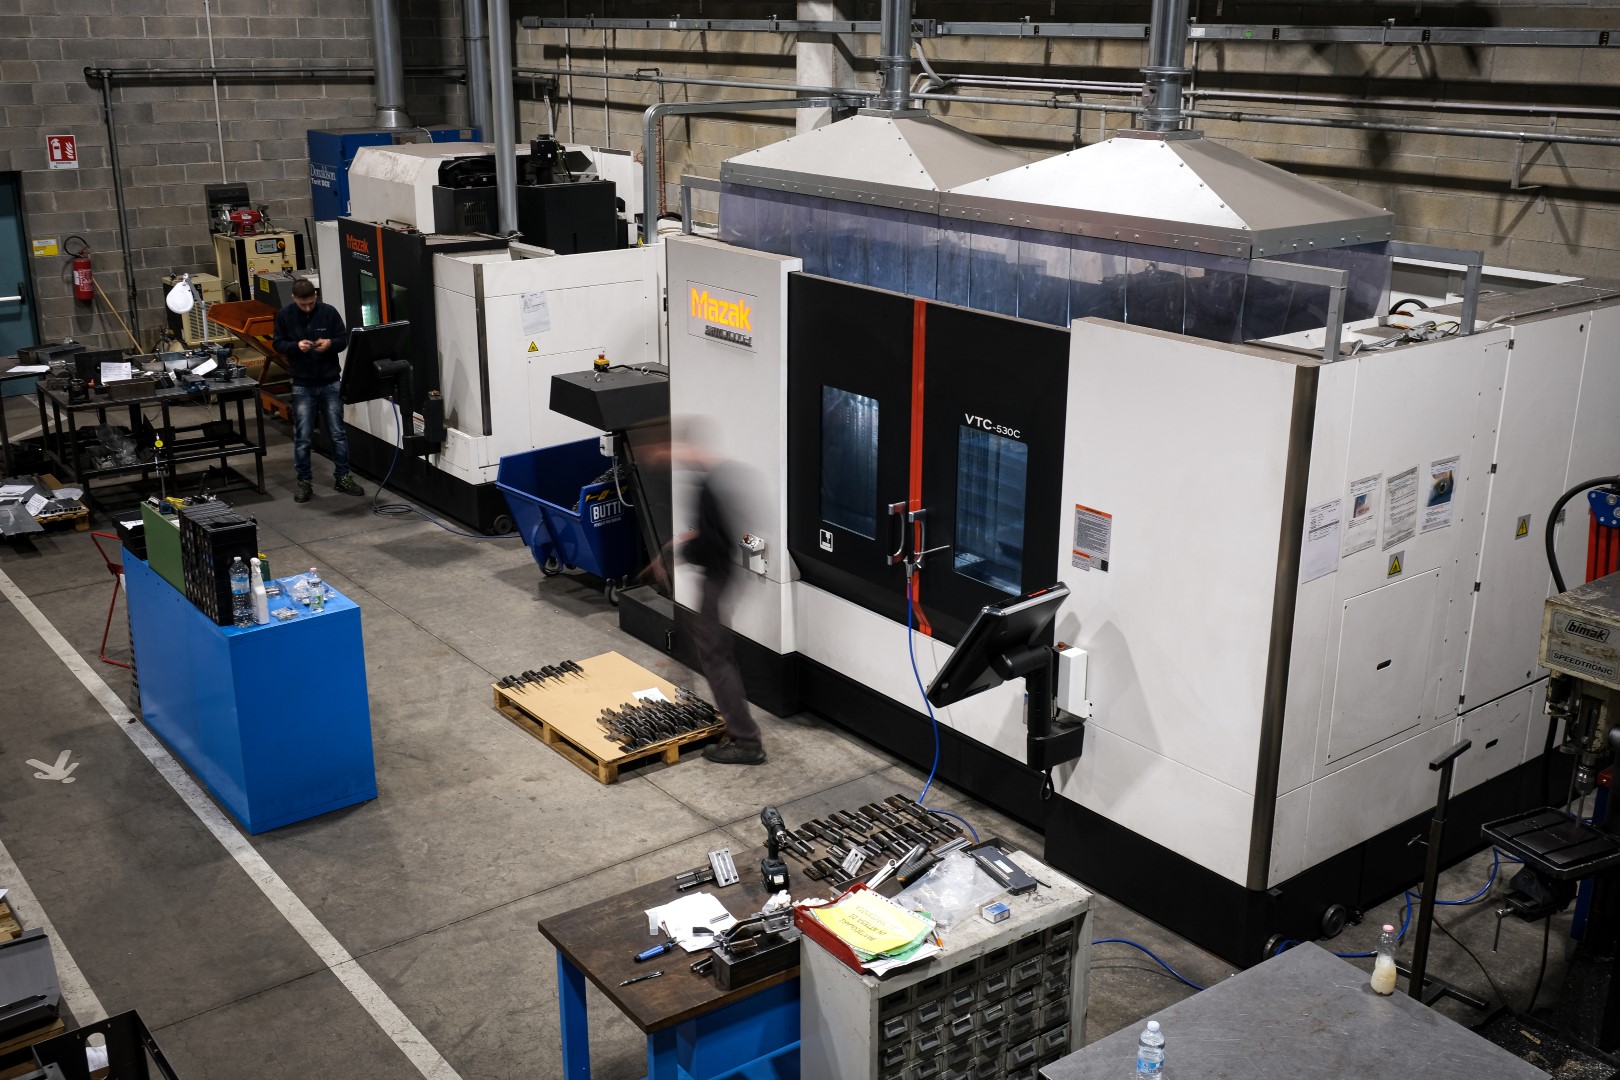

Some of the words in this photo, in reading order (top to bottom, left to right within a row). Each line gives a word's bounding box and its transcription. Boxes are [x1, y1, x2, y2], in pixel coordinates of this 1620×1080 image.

[345, 233, 370, 254] Mazak
[690, 287, 753, 332] Mazak
[964, 412, 1021, 439] VTC-530C
[592, 500, 621, 521] BUTTI
[1567, 621, 1607, 642] bimak
[1553, 652, 1614, 676] SPEEDTRONIC
